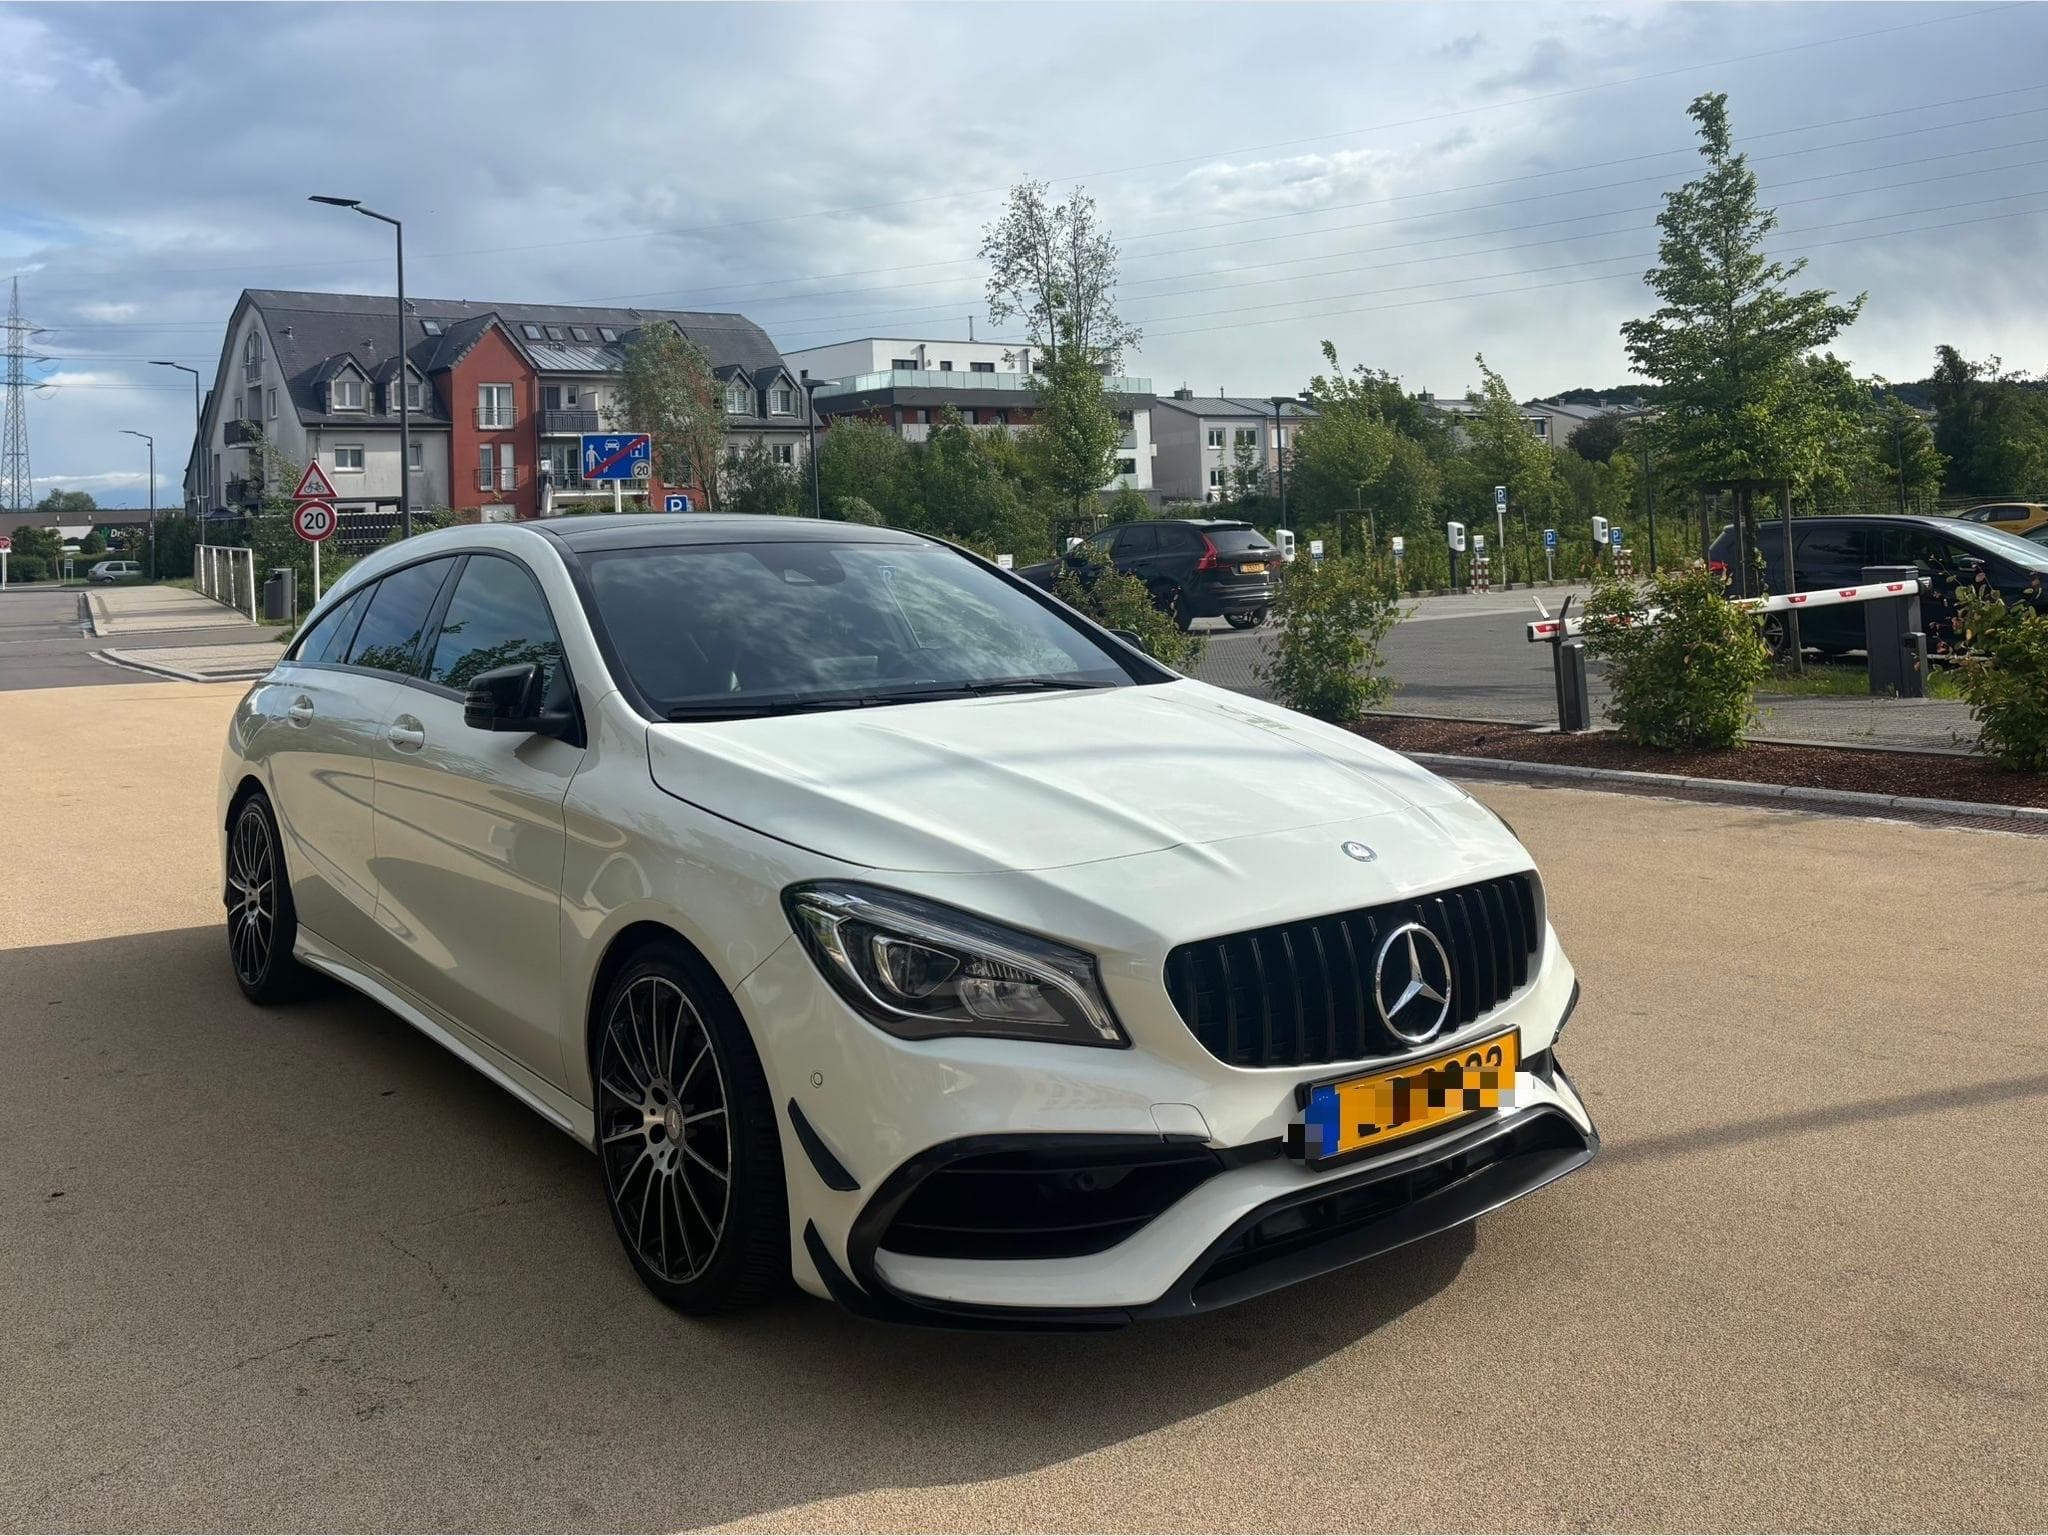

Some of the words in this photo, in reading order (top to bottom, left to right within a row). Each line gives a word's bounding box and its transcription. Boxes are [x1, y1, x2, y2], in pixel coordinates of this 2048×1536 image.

[635, 465, 649, 476] 20
[671, 499, 682, 512] P
[304, 512, 326, 529] 20
